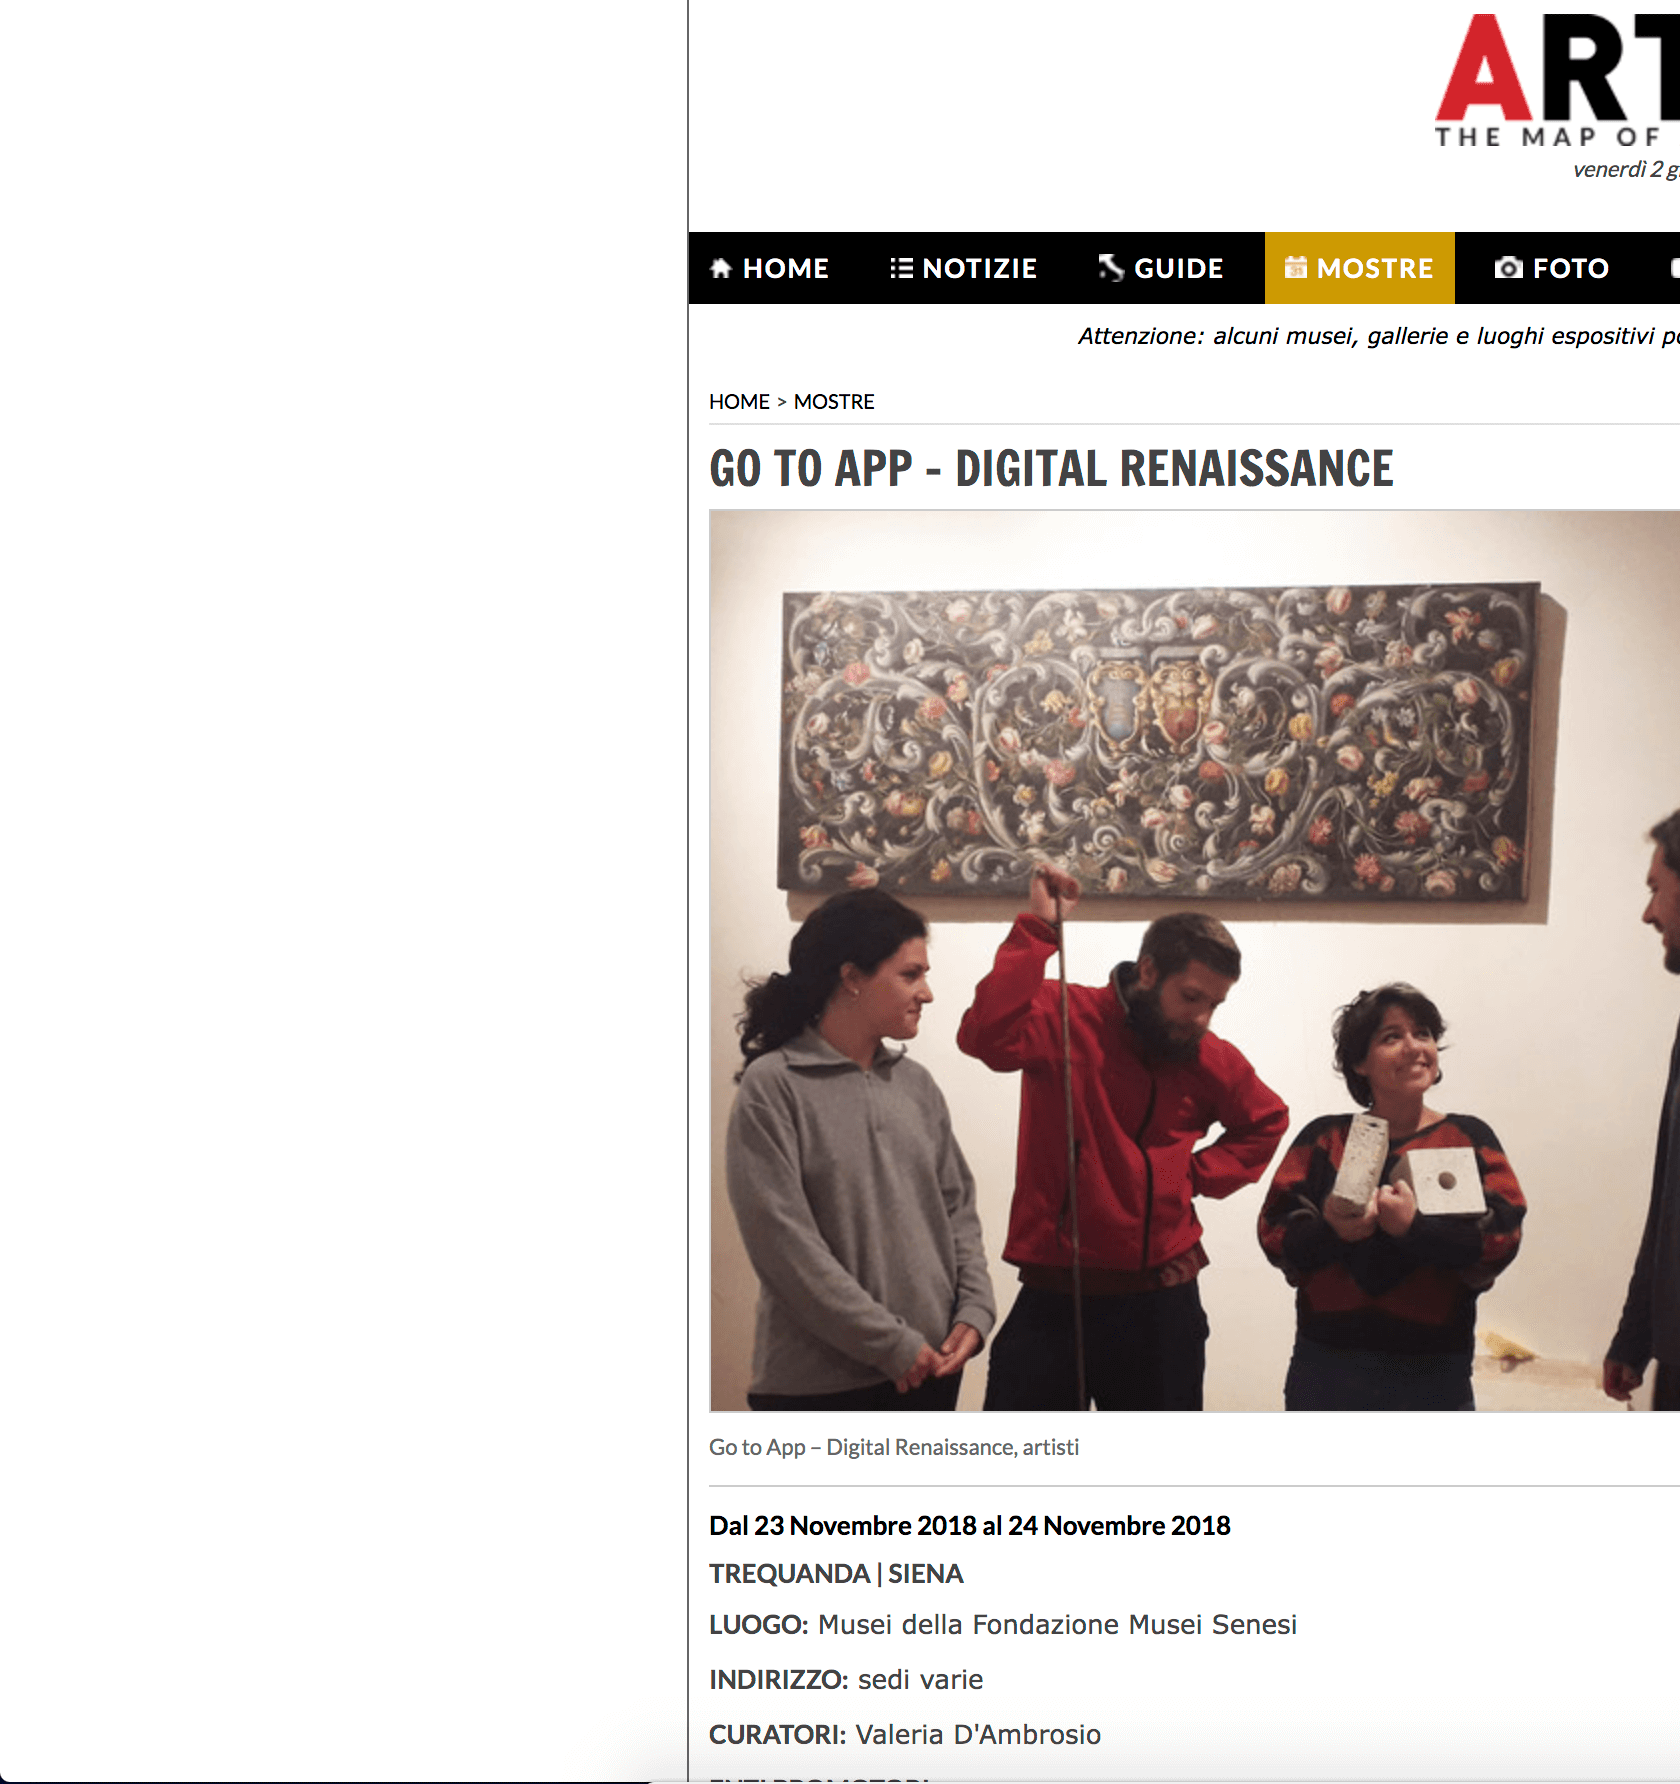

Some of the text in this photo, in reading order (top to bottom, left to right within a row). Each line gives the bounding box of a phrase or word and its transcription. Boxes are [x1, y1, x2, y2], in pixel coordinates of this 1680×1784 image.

[1435, 127, 1500, 146] THE
[1523, 127, 1595, 146] MAP
[1617, 127, 1659, 146] OF
[1574, 160, 1647, 177] venerdì
[1650, 160, 1664, 177] 2
[744, 258, 828, 279] HOME
[924, 258, 1036, 279] NOTIZIE
[1135, 258, 1223, 279] GUIDE
[1318, 258, 1433, 279] MOSTRE
[1534, 258, 1609, 279] FOTO
[1077, 327, 1204, 344] Attenzione:
[1214, 327, 1279, 344] alcuni
[1286, 327, 1358, 348] musei,
[1367, 327, 1448, 349] gallerie
[1456, 331, 1469, 344] e
[1477, 327, 1545, 349] luoghi
[1552, 327, 1656, 349] espositivi
[710, 394, 875, 409] HOME MOSTRE
[710, 449, 1393, 487] GO TO APP DIGITAL RENAISSANCE
[709, 1438, 1079, 1459] Go to App Digital Renaissance, artisti
[710, 1515, 1231, 1535] Dal 23 Novembre 2018 al 24 Novembre 2018
[709, 1563, 964, 1587] TREQUANDA SIENA
[710, 1614, 1296, 1634] LUOGO: Musei della Fondazione Musei Senesi
[711, 1669, 983, 1689] INDIRIZZO: sedi varie
[709, 1724, 1101, 1744] CURATORI: Valeria D'Ambrosio
